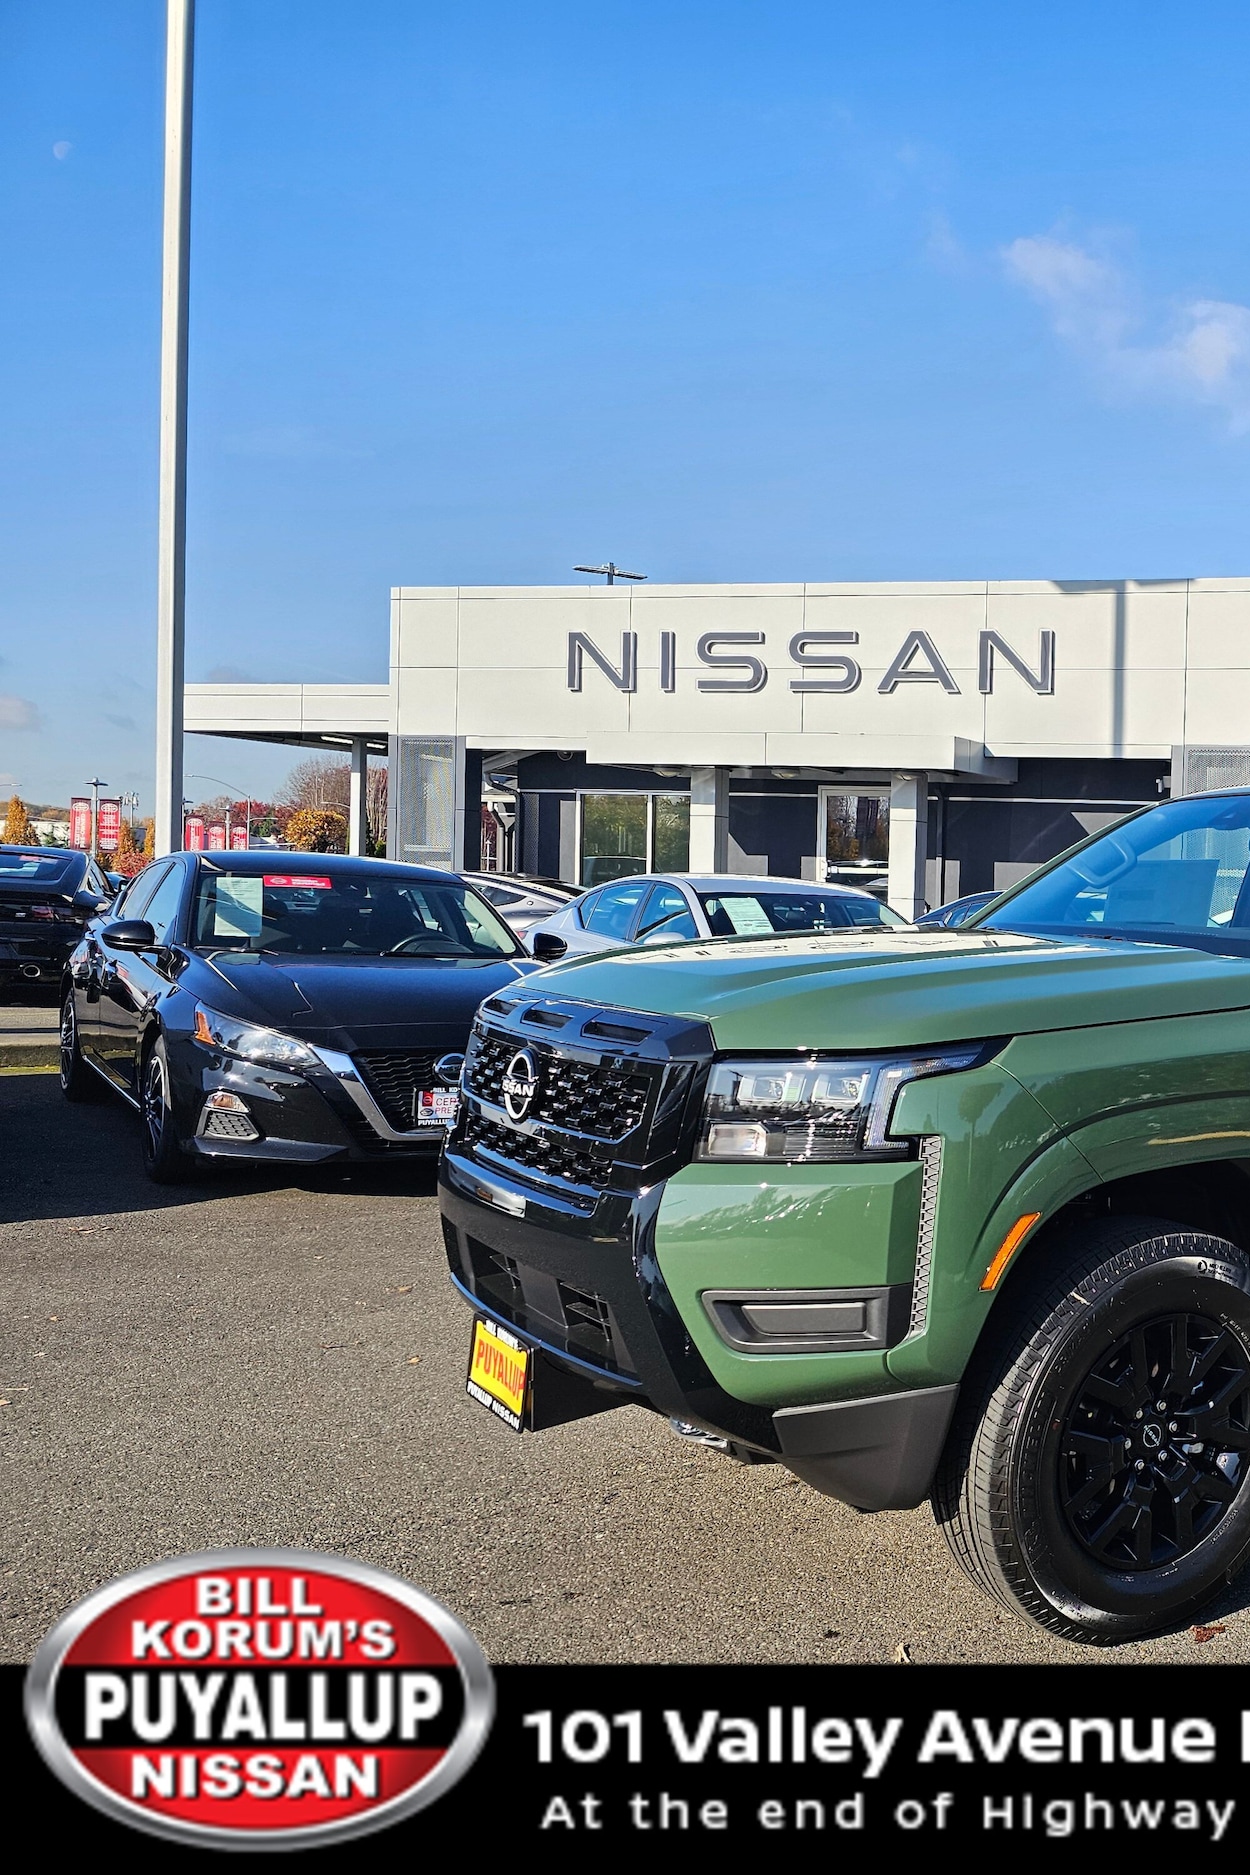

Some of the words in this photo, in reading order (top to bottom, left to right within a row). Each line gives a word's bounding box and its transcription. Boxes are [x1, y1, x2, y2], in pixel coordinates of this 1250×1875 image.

[566, 629, 1057, 694] NISSAN
[502, 1079, 535, 1097] SSAN
[418, 1118, 449, 1126] PUYALLU
[435, 1106, 452, 1115] PRE
[475, 1338, 526, 1401] PUYALLUP
[492, 1400, 520, 1430] NISSAN
